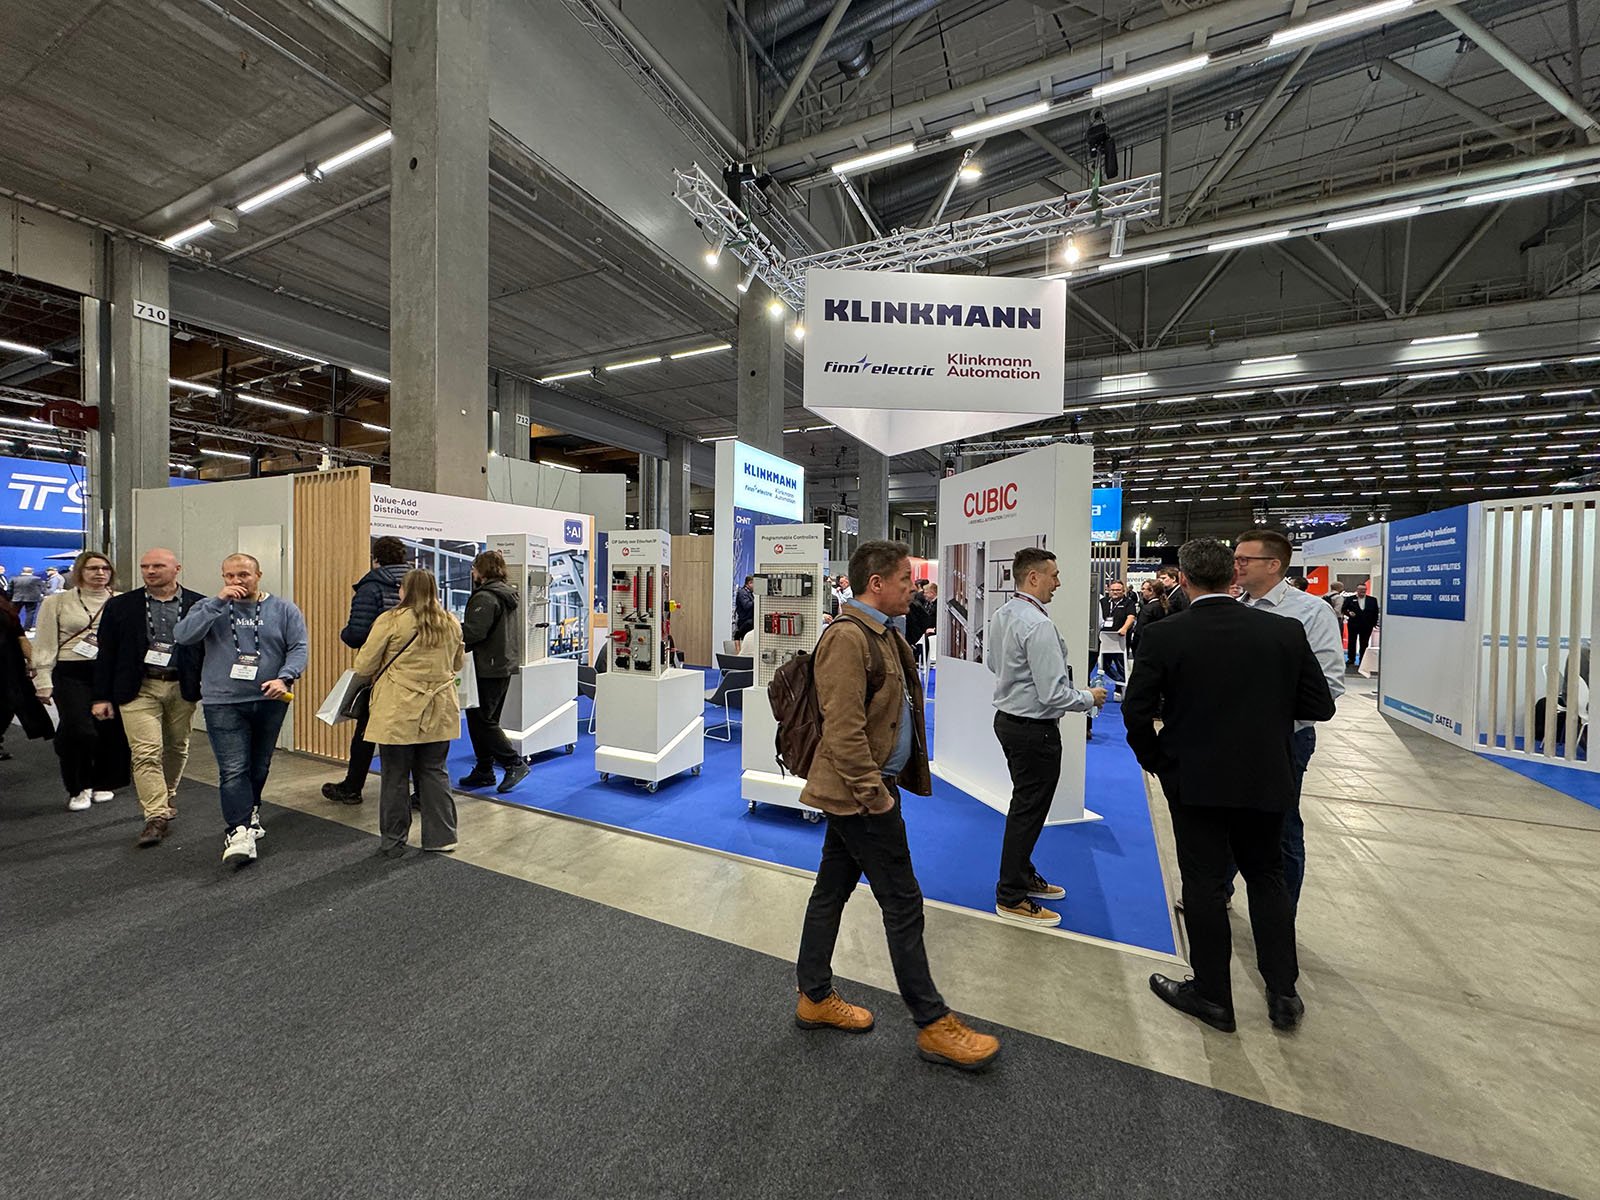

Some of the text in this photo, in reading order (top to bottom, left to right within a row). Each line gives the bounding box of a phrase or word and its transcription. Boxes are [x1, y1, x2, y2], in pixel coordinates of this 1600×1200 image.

[137, 304, 166, 320] 710
[824, 299, 1041, 330] KLINKMANN
[947, 353, 1032, 368] Klinkmann
[946, 366, 1041, 380] Automation
[517, 415, 529, 425] 712
[744, 462, 797, 490] KLINKMANN
[373, 494, 417, 507] Value-Add
[963, 482, 1018, 518] CUBIC
[373, 504, 419, 516] Distributor
[571, 526, 581, 538] AI
[1295, 532, 1315, 540] LST
[1434, 526, 1457, 536] solutions
[236, 618, 264, 626] Maka
[1435, 714, 1453, 729] SATEL
